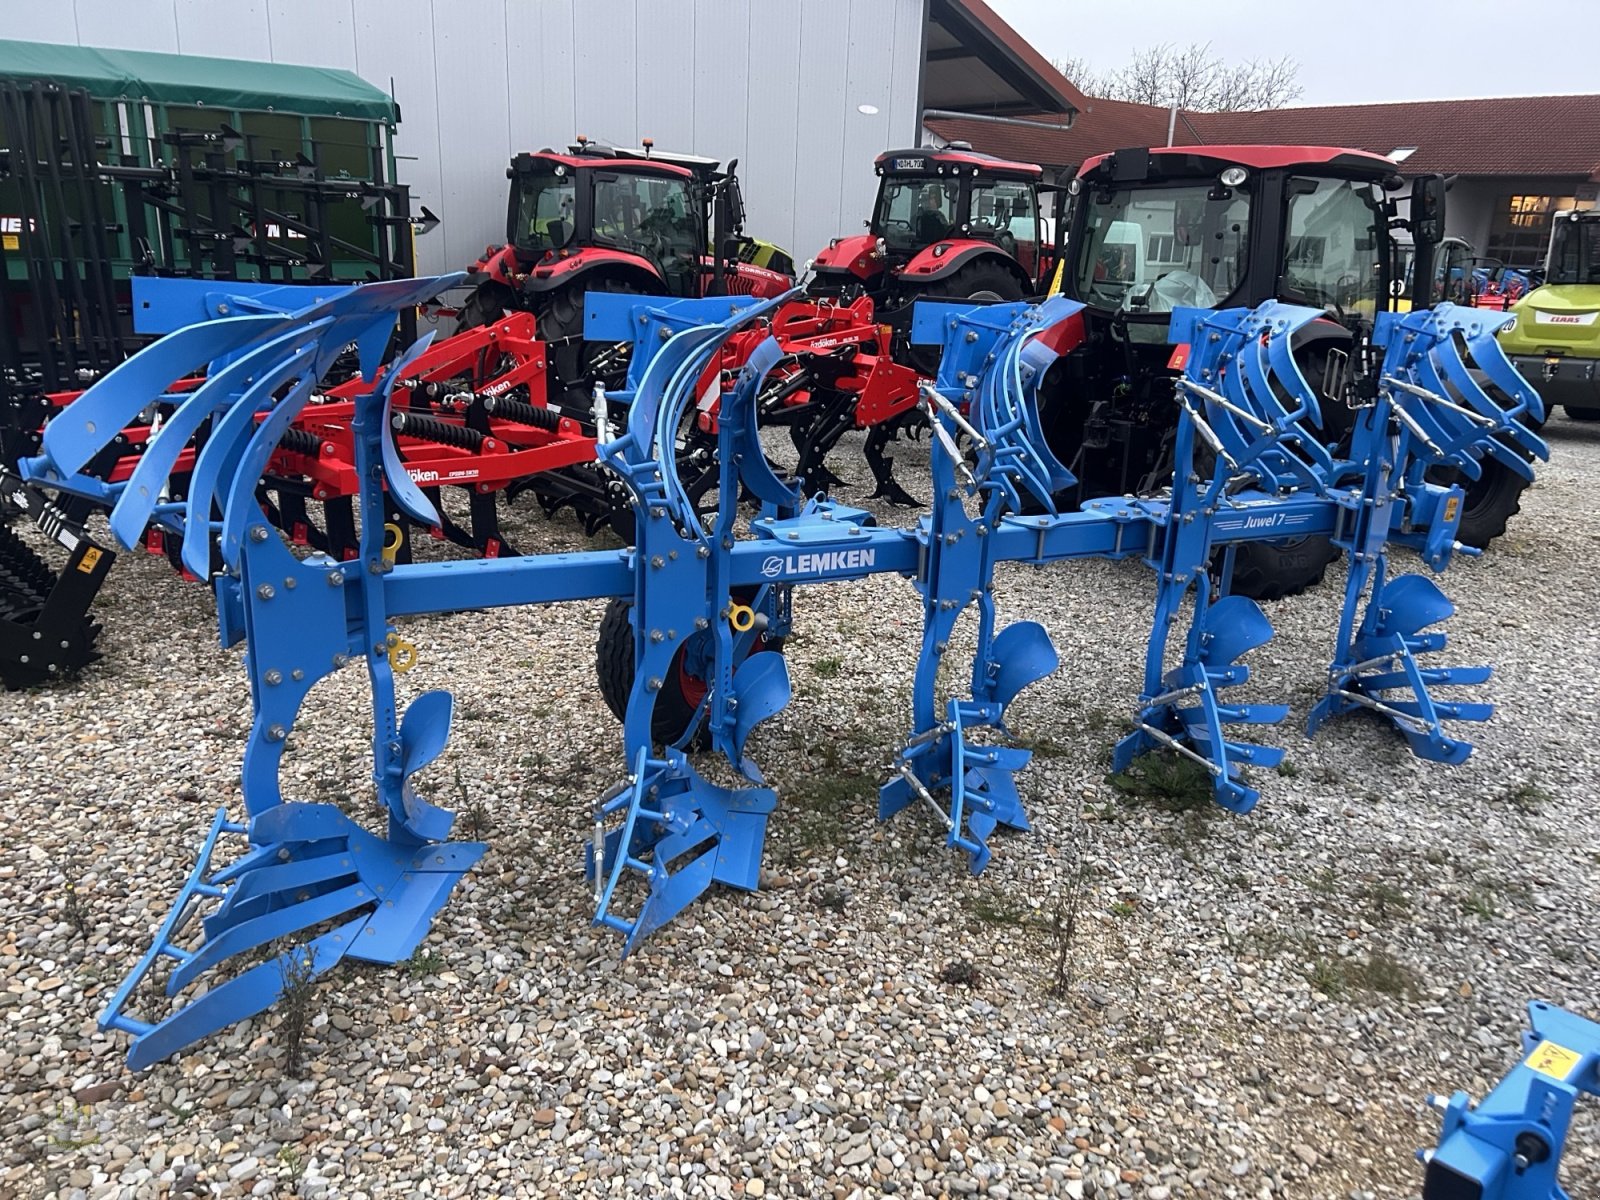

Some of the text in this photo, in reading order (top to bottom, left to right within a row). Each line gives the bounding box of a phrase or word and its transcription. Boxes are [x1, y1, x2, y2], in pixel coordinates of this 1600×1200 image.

[1550, 315, 1581, 324] CLAAS
[1243, 513, 1286, 529] Juwel 7
[785, 548, 876, 576] LEMKEN
